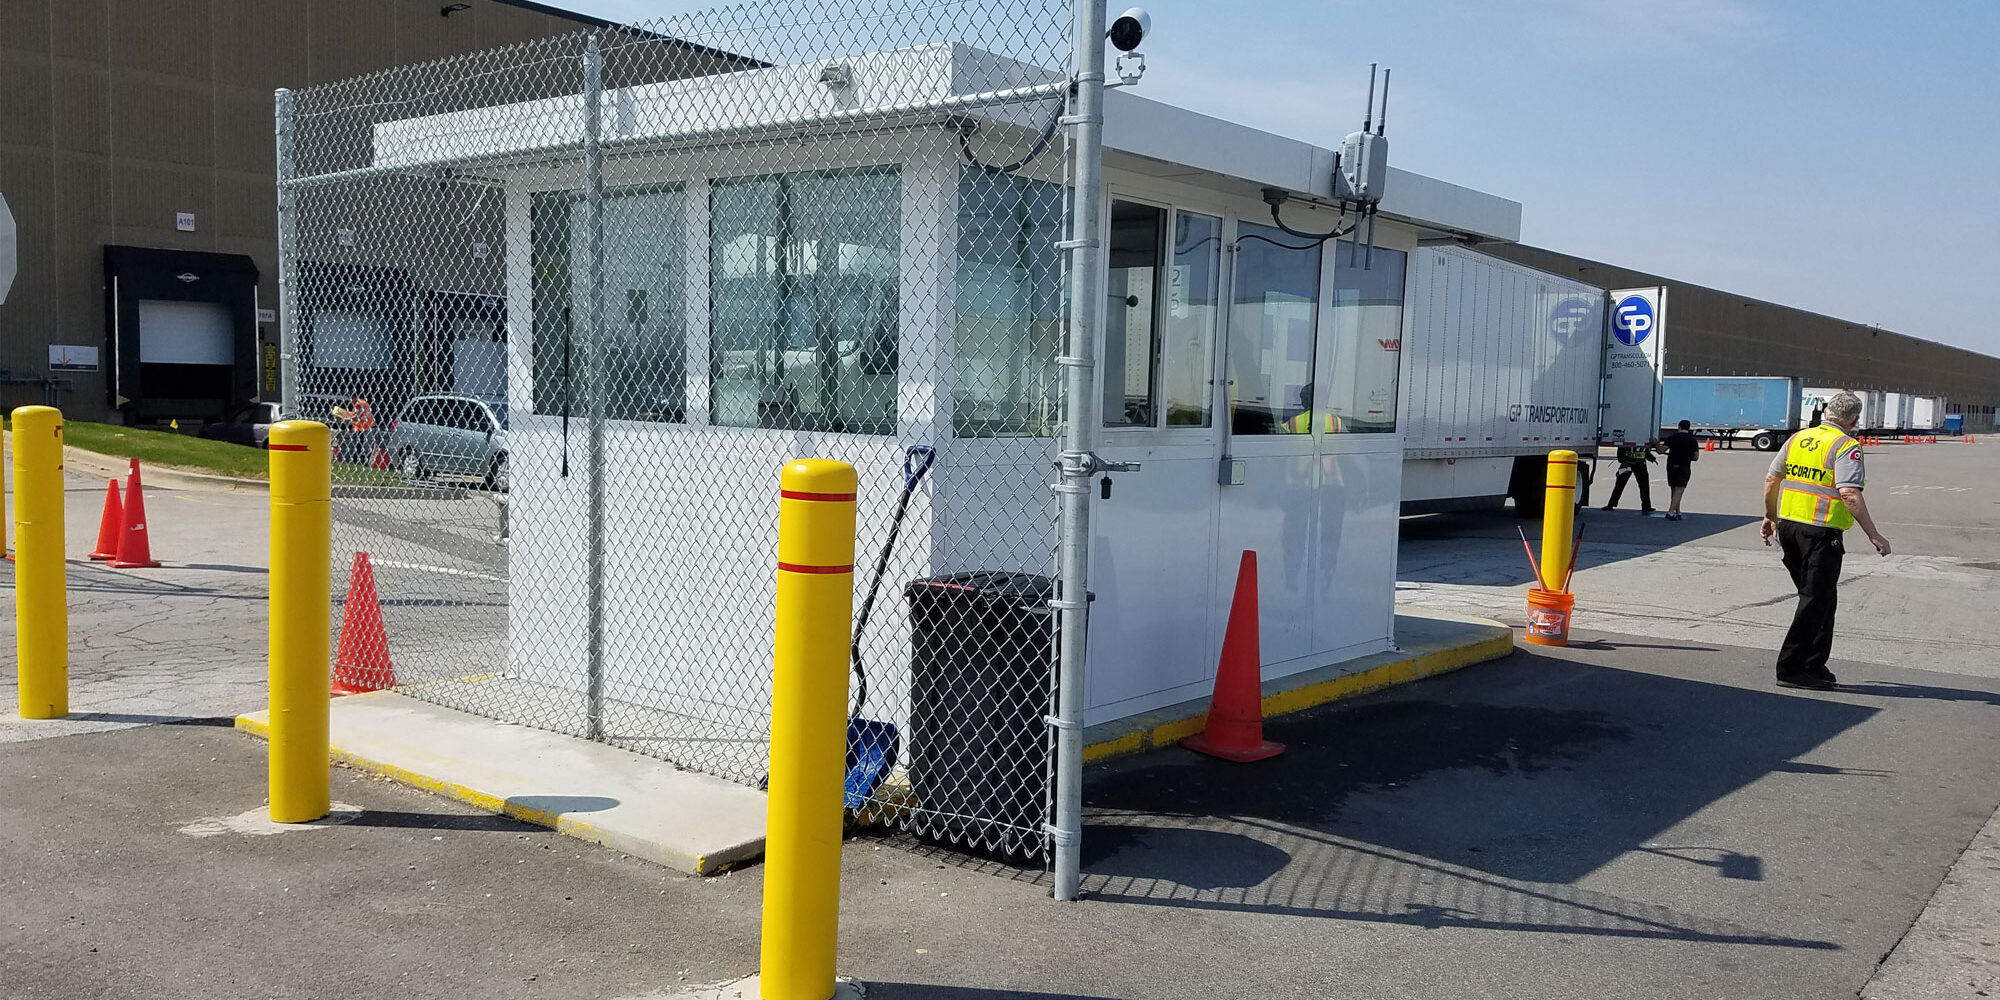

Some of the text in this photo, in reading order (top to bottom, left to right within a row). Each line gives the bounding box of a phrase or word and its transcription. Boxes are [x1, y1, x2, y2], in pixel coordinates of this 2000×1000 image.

[178, 217, 194, 226] A101
[1615, 305, 1652, 345] GP
[1509, 404, 1589, 424] GP TRANSPORTATION
